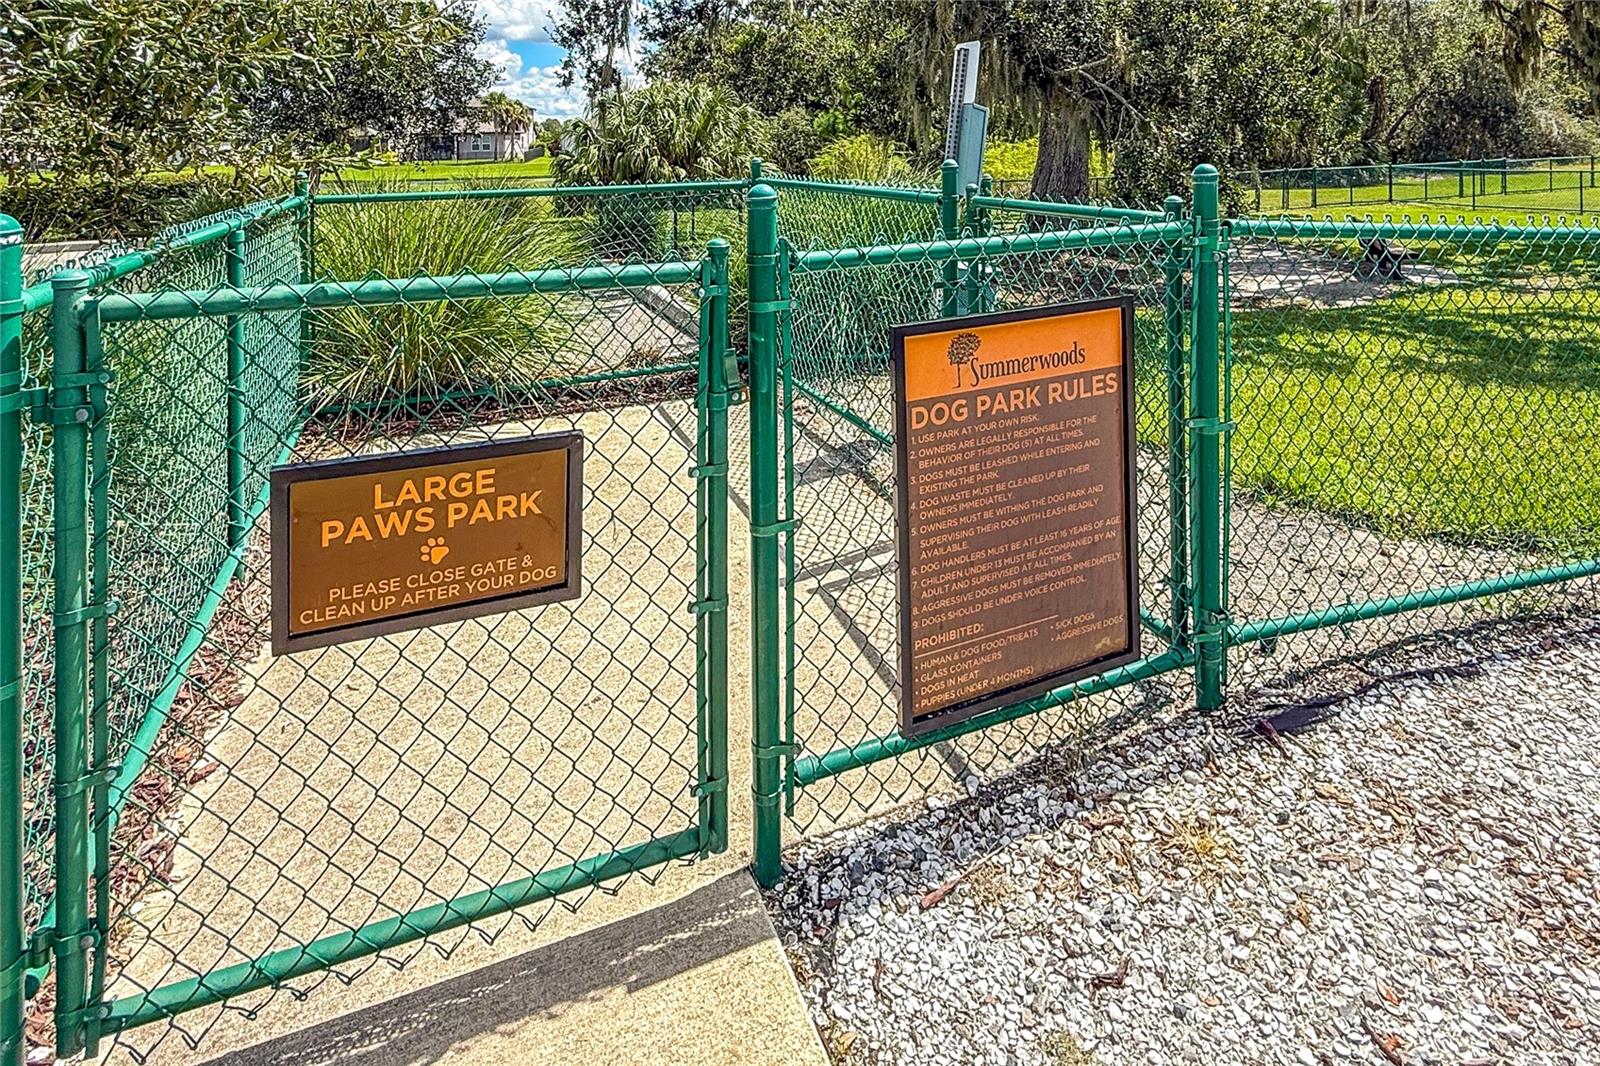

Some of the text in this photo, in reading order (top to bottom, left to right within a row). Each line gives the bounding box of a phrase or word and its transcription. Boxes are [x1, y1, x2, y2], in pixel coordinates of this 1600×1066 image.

[969, 341, 1085, 387] Summerwoods
[910, 371, 1118, 430] DOG PARK RULES
[910, 414, 1096, 459] 2. OWNERS ARE LEGALLY RESPONSIBLE FOR THE
[911, 413, 1039, 444] 1. USE PARK AT YOUR OWN RISK.
[918, 452, 962, 469] BEHAVIOR
[963, 450, 976, 460] OF
[977, 445, 1000, 457] THEIR
[1001, 441, 1020, 452] DOG
[1021, 438, 1032, 448] (S)
[1033, 436, 1044, 445] AT
[1045, 433, 1060, 443] ALL
[918, 470, 943, 483] DOGS
[945, 465, 968, 477] MUST
[969, 462, 980, 472] BE
[981, 455, 1017, 470] LEASHED
[1019, 449, 1044, 462] WHILE
[1045, 441, 1082, 456] ENTERING
[1083, 437, 1100, 448] AND
[374, 469, 496, 510] LARGE
[919, 478, 957, 494] EXISTING
[958, 475, 975, 486] THE
[919, 496, 938, 508] DOG
[940, 489, 971, 503] WASTE
[972, 484, 994, 496] MUST
[995, 481, 1006, 491] BE
[1007, 473, 1044, 488] CLEANED
[1045, 470, 1056, 480] UP
[1056, 468, 1067, 478] BY
[1068, 463, 1090, 475] THEIR
[919, 491, 1015, 520] OWNERS IMMEDIATELY.
[321, 490, 542, 547] PAWS PARK
[911, 483, 1103, 536] 5. OWNERS MUST BE WITHING THE DOG PARK AND
[920, 497, 1099, 548] SUPERVISING THEIR DOG WITH LEASH READILY
[911, 566, 919, 576] 6.
[920, 561, 939, 573] DOG
[941, 549, 985, 568] HANDLERS
[987, 543, 1009, 556] MUST
[1010, 540, 1021, 550] BE
[1022, 537, 1033, 547] AT
[1034, 531, 1058, 544] LEAST
[1059, 528, 1067, 538] 16
[1068, 522, 1093, 536] YEARS
[1093, 519, 1104, 529] OF
[912, 529, 1115, 590] 7. CHILDREN UNDER 13 MUST BE ACCOMPANIED BY AN
[299, 566, 556, 625] CLEAN UP AFTER YOUR DOG
[329, 554, 533, 602] PLEASE CLOSE GATE &
[921, 584, 948, 599] ADULT
[950, 579, 969, 591] AND
[971, 565, 1019, 586] SUPERVISED
[1021, 562, 1032, 572] AT
[1033, 558, 1048, 569] ALL
[921, 591, 974, 613] AGGRESSIVE
[975, 584, 999, 598] DOGS
[999, 578, 1022, 591] MUST
[1022, 575, 1033, 585] BE
[1034, 564, 1072, 582] REMOVED
[921, 612, 946, 627] DOGS
[947, 602, 982, 619] SHOULD
[983, 599, 994, 609] BE
[995, 591, 1023, 606] UNDER
[1023, 584, 1048, 598] VOICE
[1049, 573, 1087, 591] CONTROL.
[914, 621, 984, 651] PROHIBITED:
[1054, 610, 1095, 630] SICK DOGS
[1055, 620, 1102, 642] AGGRESSIVE
[920, 627, 1038, 670] HUMAN & DOG FOOD/TREATS
[920, 650, 1002, 683] GLASS CONTAINERS
[920, 669, 979, 696] DOGS IN HEAT
[920, 665, 1033, 708] PUPPIES (UNDER 4 MONTHS)
